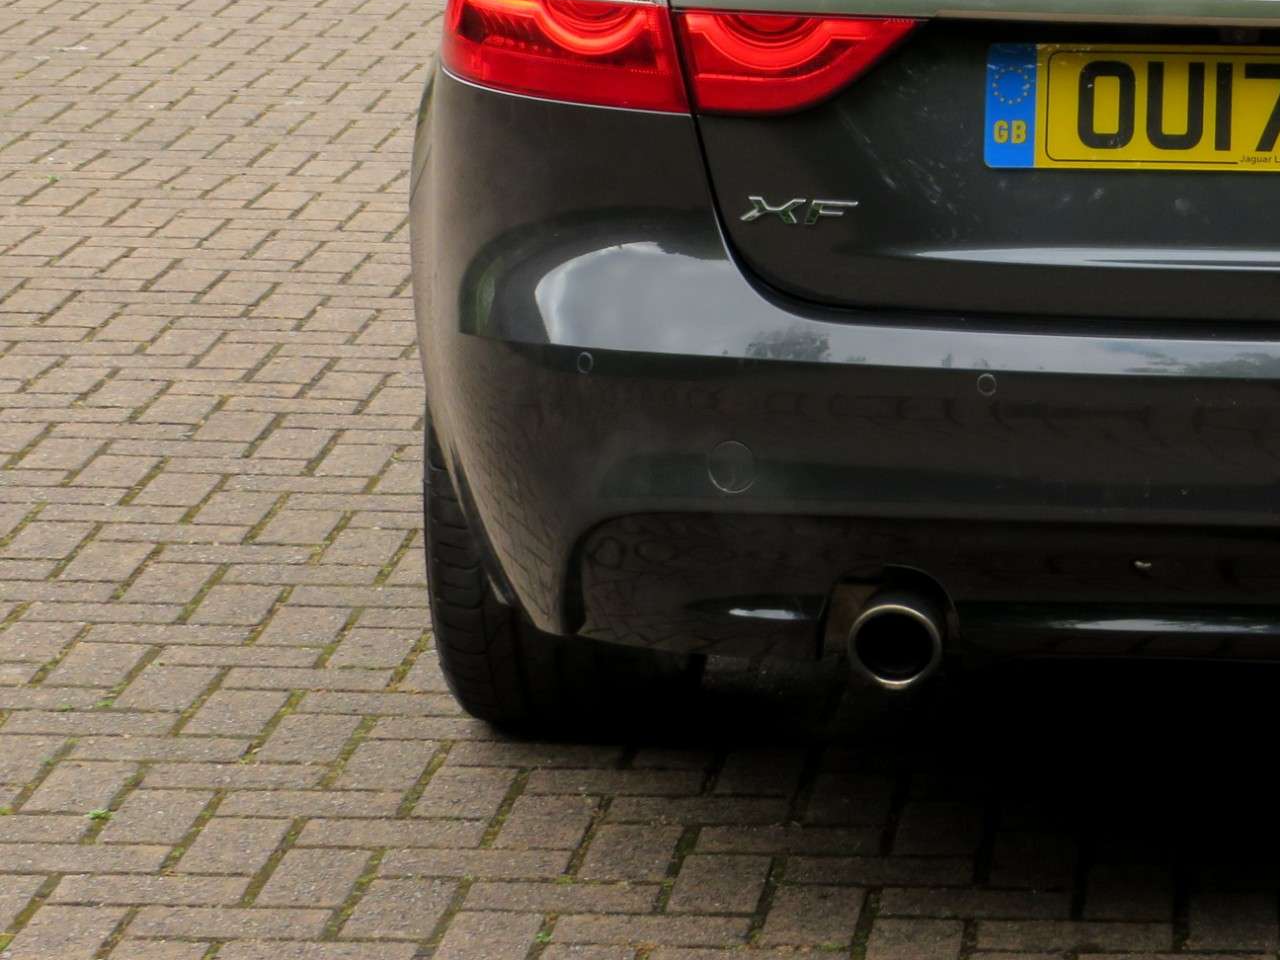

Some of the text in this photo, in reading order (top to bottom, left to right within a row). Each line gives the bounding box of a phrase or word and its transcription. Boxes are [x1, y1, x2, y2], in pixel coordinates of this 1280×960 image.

[994, 120, 1027, 144] GB
[1240, 154, 1272, 165] Jaguar
[740, 195, 859, 224] XF
